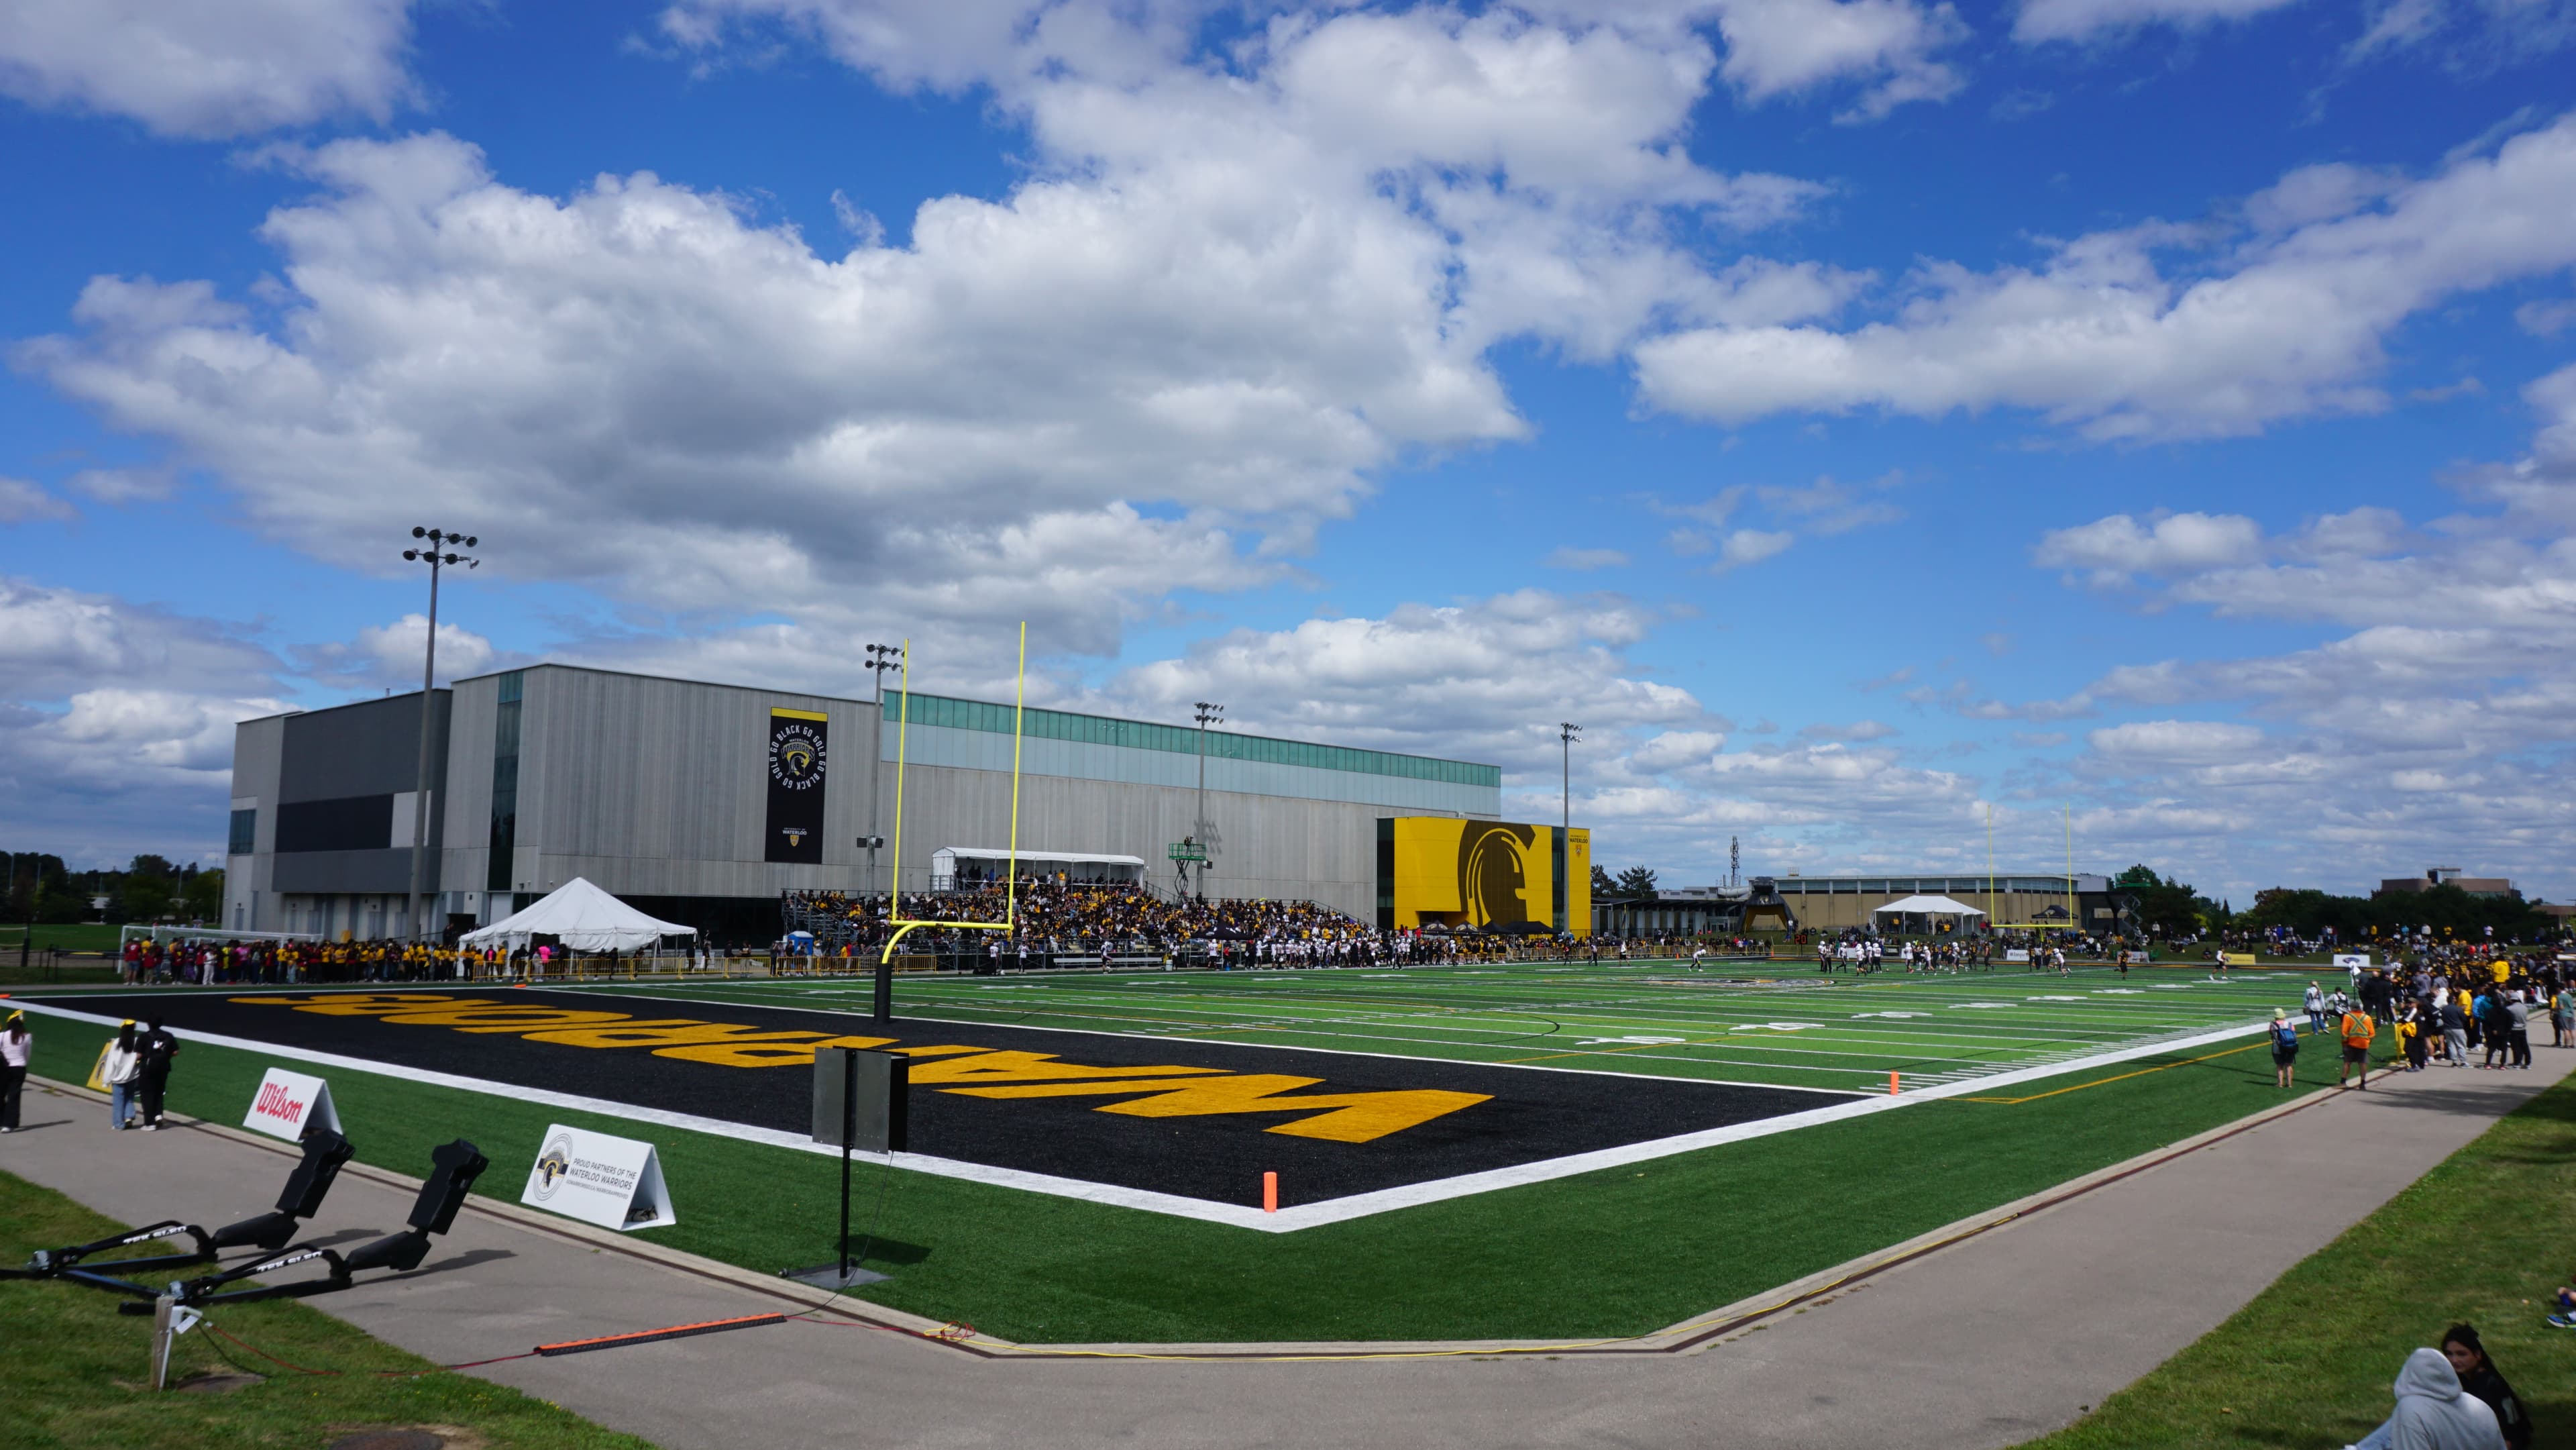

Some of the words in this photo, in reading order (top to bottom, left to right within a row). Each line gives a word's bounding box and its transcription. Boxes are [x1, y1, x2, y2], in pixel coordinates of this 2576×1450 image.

[776, 725, 800, 741] BLACK
[803, 727, 813, 737] GO
[770, 741, 780, 753] GO
[781, 743, 815, 762] WARRIORS
[813, 735, 826, 756] GOLD
[769, 757, 783, 779] GOLD
[817, 760, 826, 772] GO
[782, 778, 793, 788] GO
[796, 773, 820, 790] BLACK
[1795, 935, 1807, 944] 20
[257, 1082, 303, 1124] Wilson
[574, 1158, 590, 1168] PROUD
[590, 1161, 616, 1174] PARTNERS
[617, 1168, 625, 1176] OF
[625, 1170, 637, 1180] THE
[570, 1168, 600, 1182] WATERLOO
[600, 1175, 633, 1190] WARRIORS
[123, 1233, 150, 1244] TEK
[152, 1225, 186, 1239] SLED
[256, 1259, 285, 1272] TEK
[287, 1250, 322, 1264] SLED
